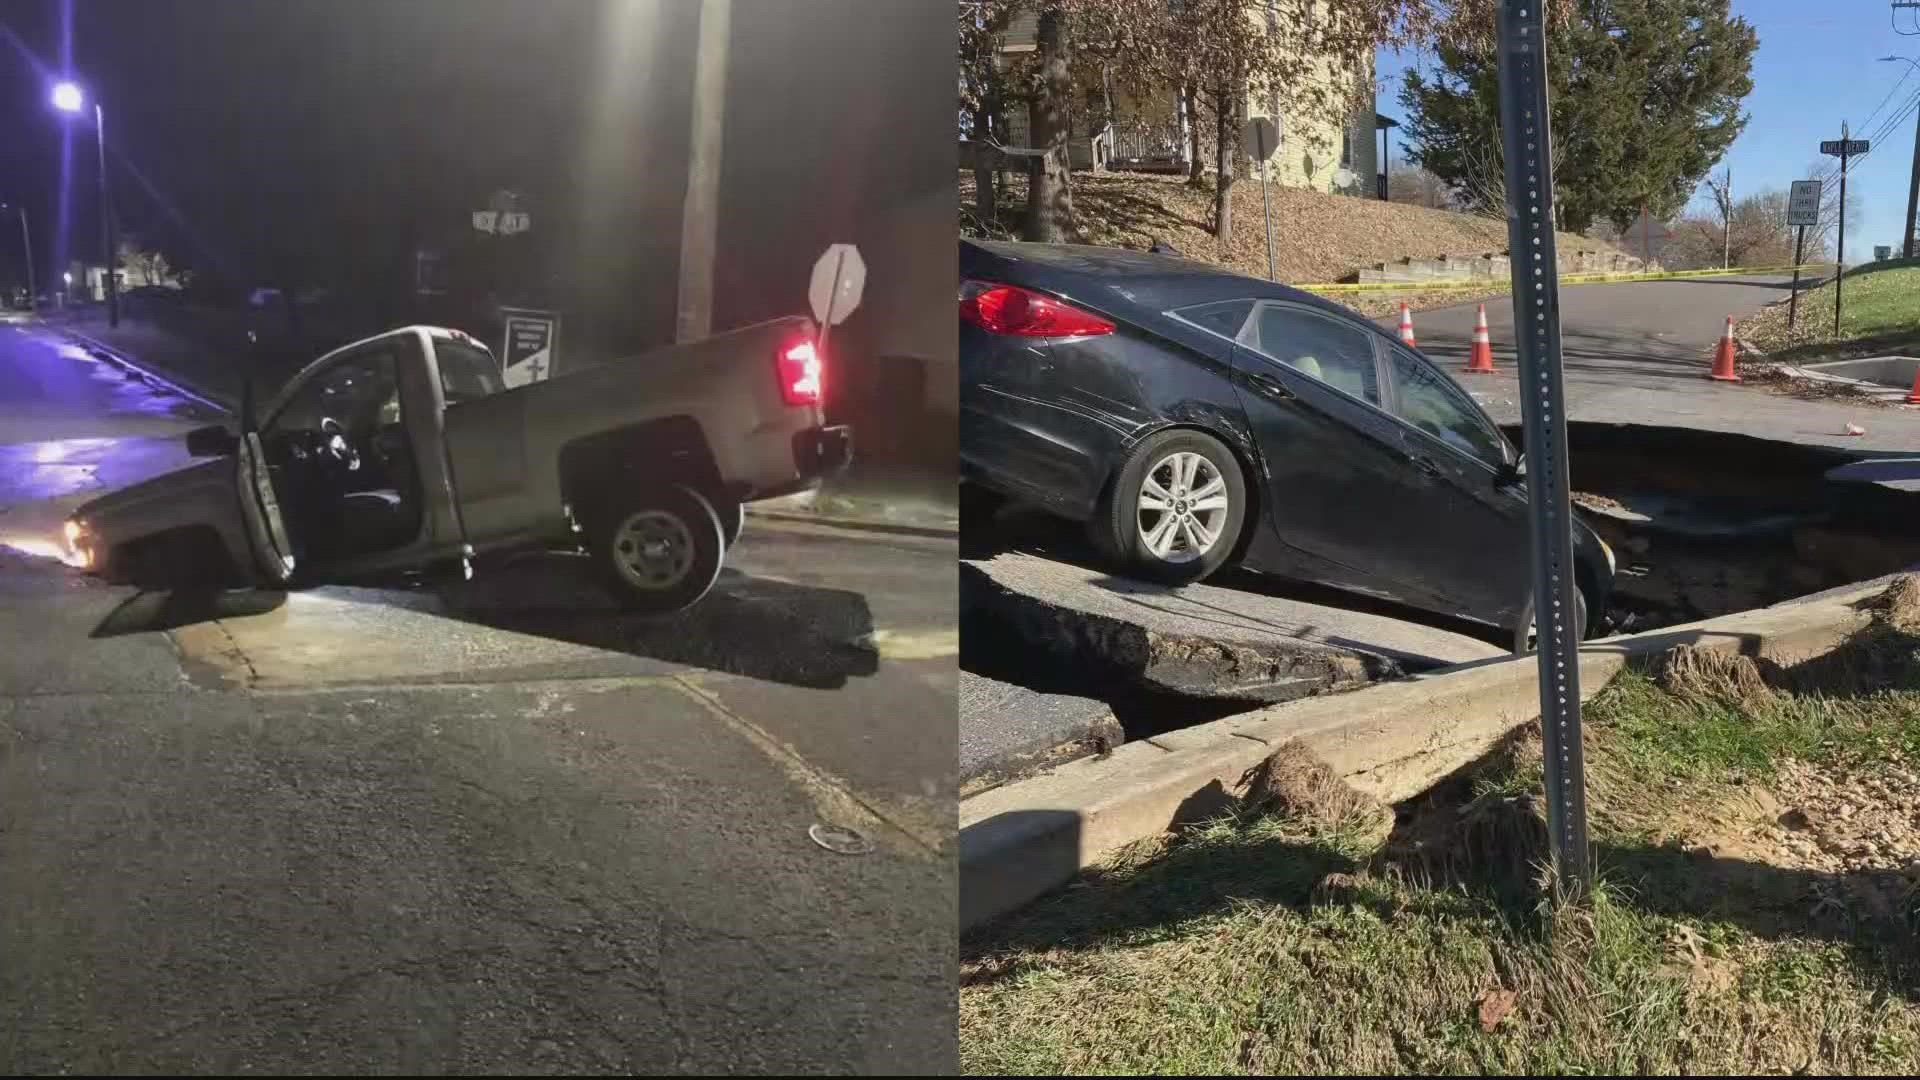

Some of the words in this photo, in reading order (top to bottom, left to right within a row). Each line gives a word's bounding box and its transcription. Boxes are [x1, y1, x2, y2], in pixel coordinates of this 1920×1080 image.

[1800, 185, 1812, 195] NO
[1796, 198, 1814, 208] THRU
[1791, 210, 1816, 220] TRUCKS
